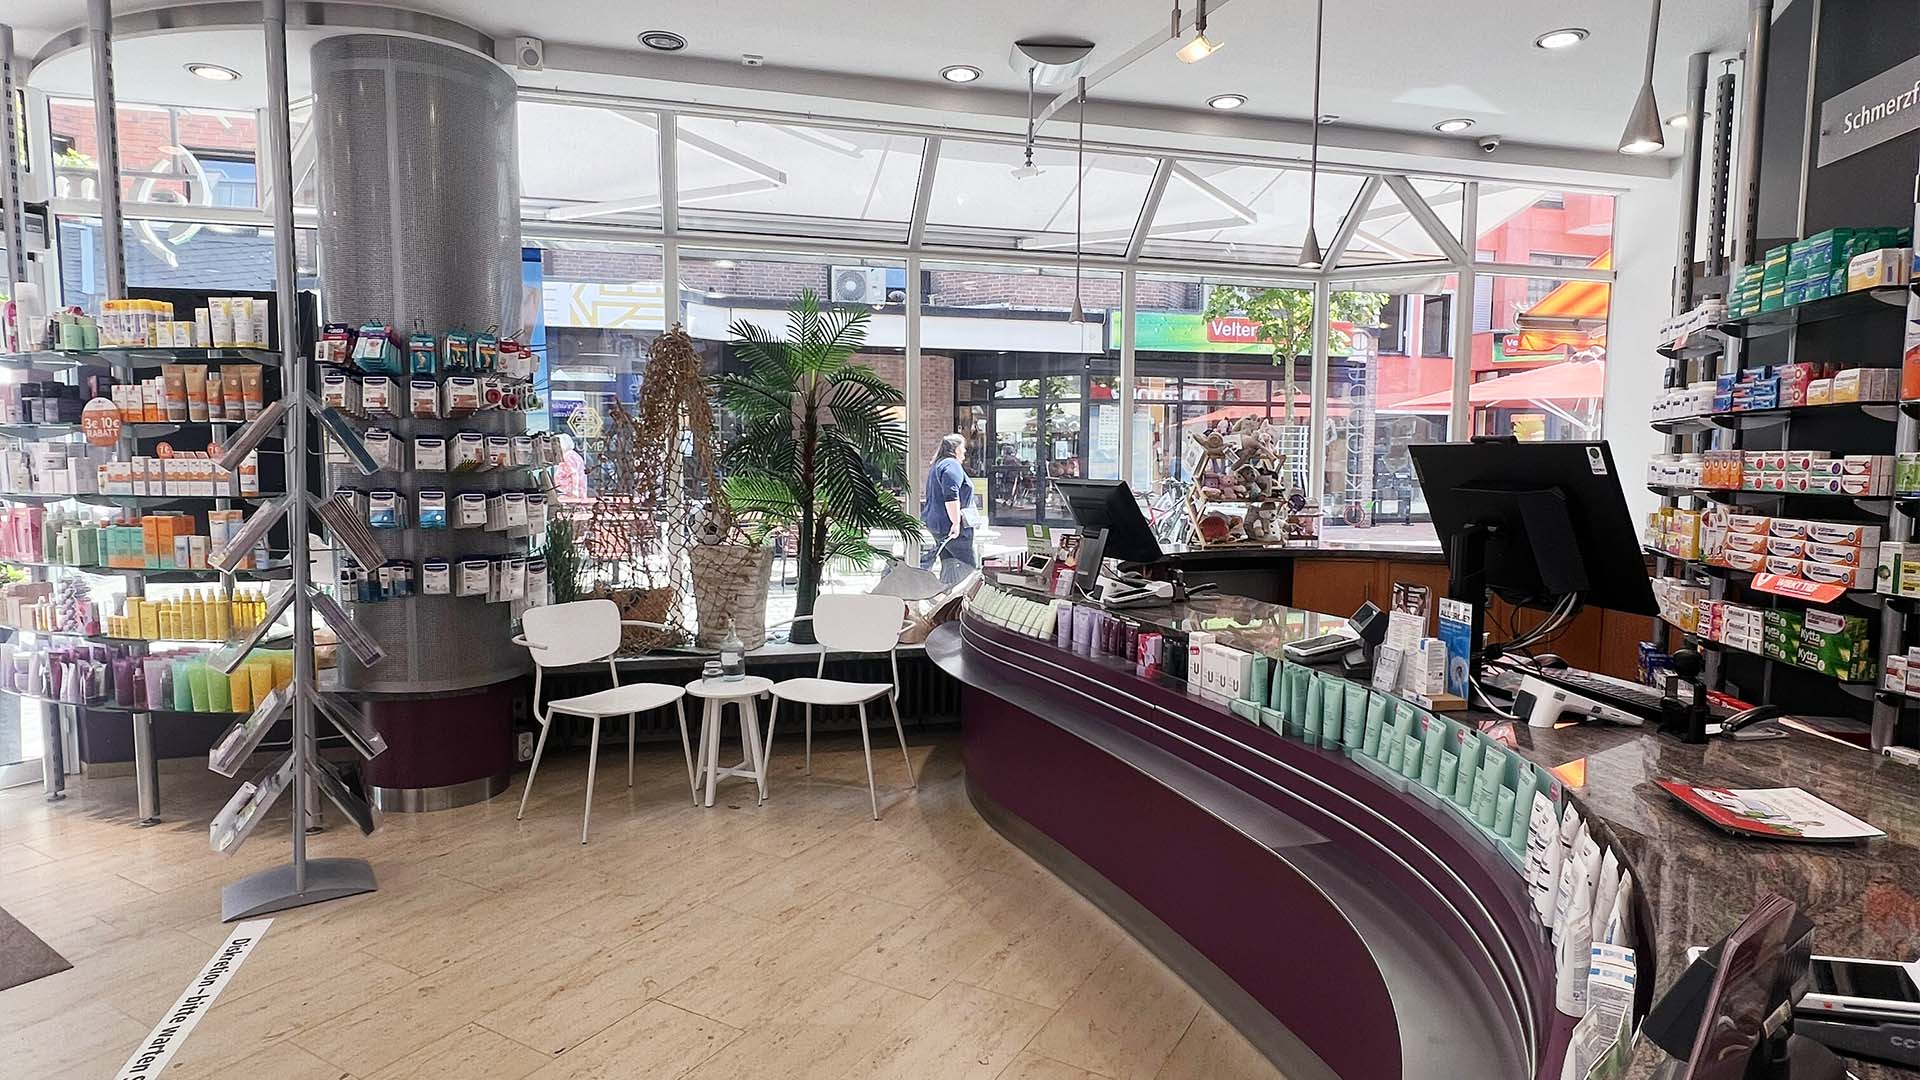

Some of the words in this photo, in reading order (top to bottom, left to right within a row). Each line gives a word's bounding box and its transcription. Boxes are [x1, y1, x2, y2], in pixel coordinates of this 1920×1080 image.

[86, 429, 119, 438] RABATT
[1800, 628, 1821, 642] Kytta
[1797, 647, 1818, 661] Kytta
[197, 937, 252, 987] Diskretion
[168, 994, 210, 1024] bitte
[128, 1025, 181, 1074] warten
